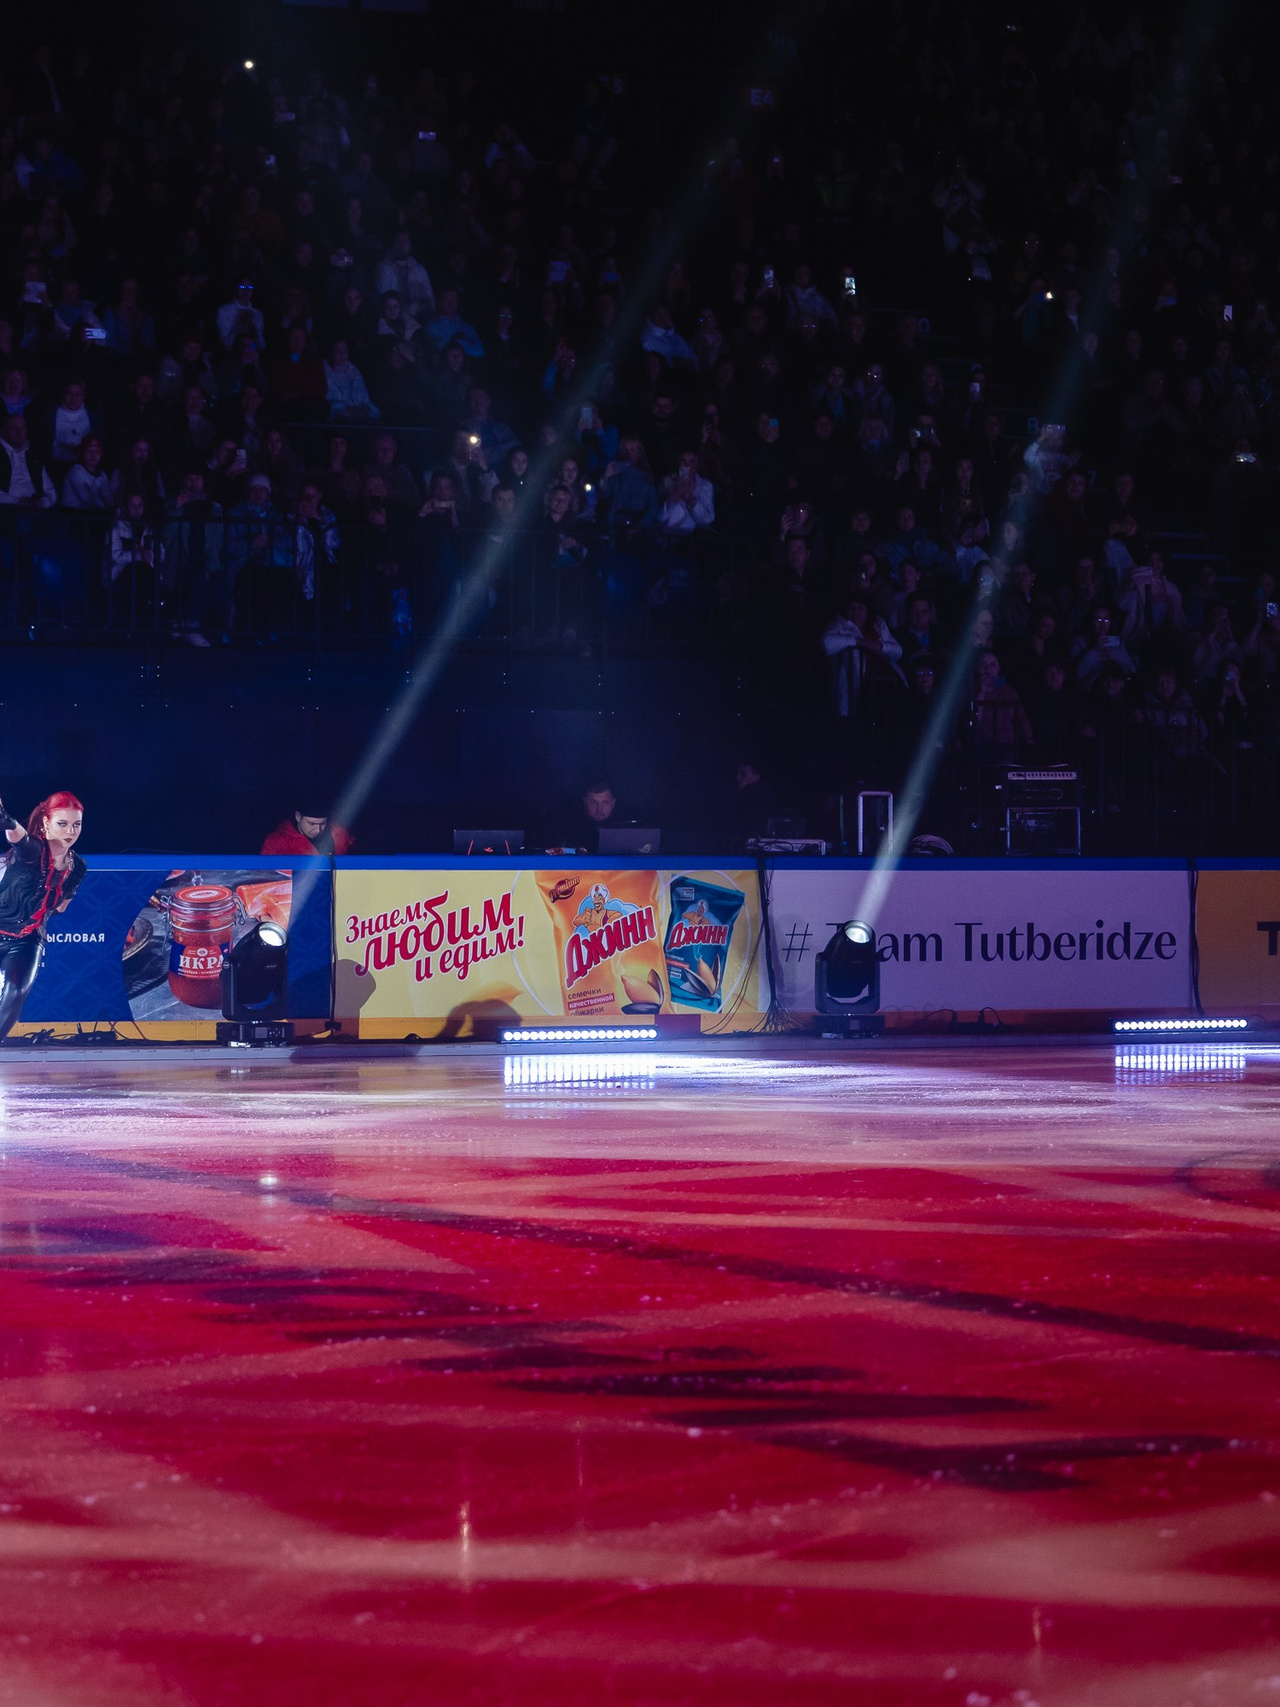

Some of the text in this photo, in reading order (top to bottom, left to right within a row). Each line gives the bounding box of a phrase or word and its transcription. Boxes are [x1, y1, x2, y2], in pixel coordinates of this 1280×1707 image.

[345, 902, 428, 943] Знаем,
[46, 933, 105, 943] ЫСЛОВАЯ
[415, 915, 525, 982] и едим!
[955, 919, 1177, 962] Tutberidze
[568, 988, 602, 999] семечки
[569, 994, 614, 1009] качественной
